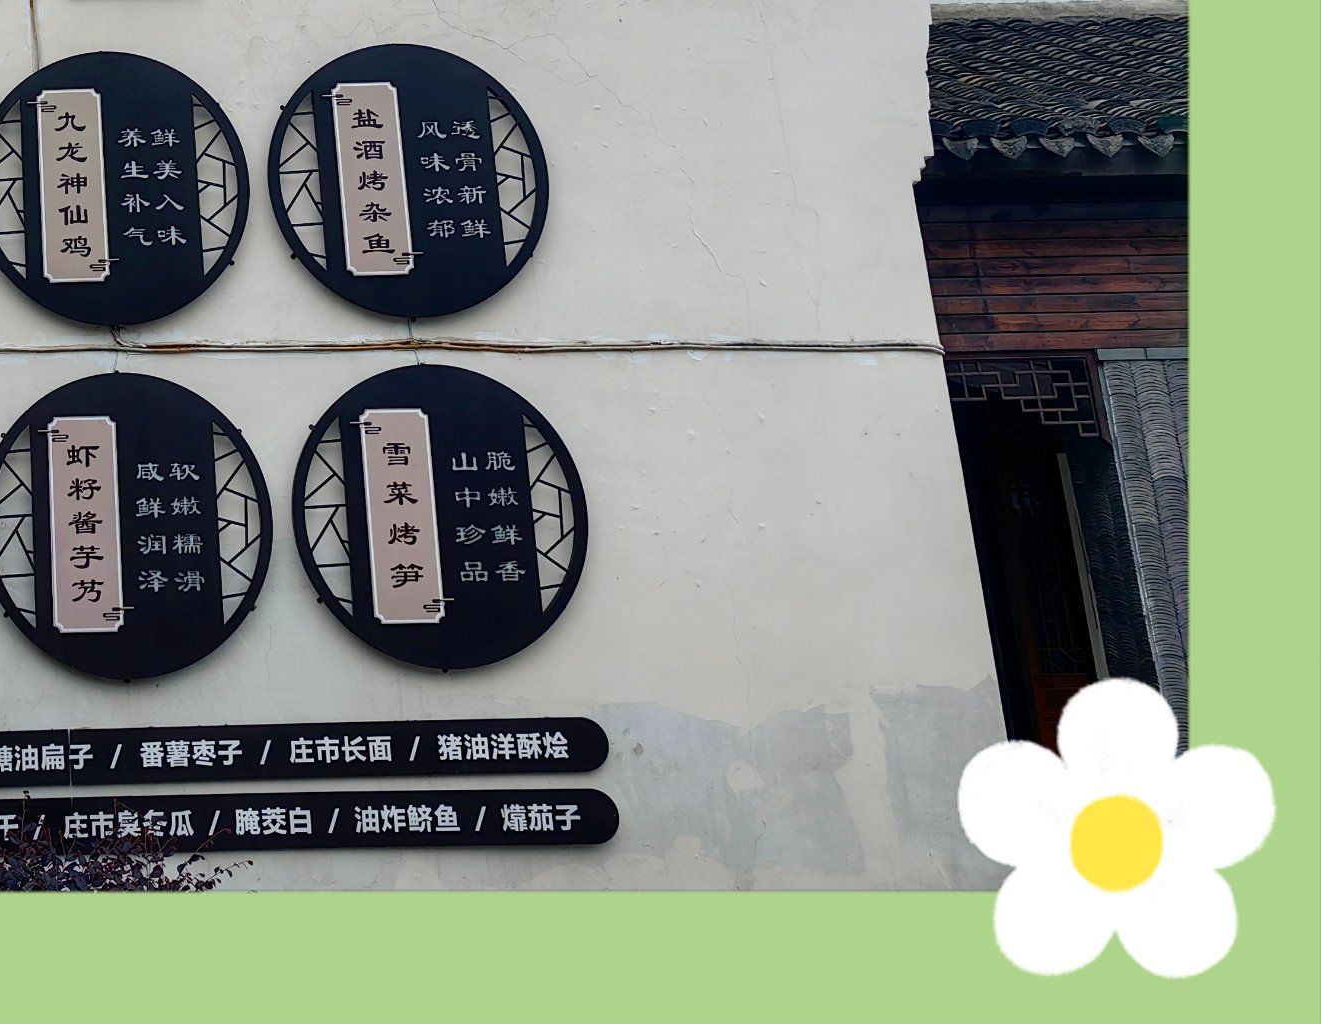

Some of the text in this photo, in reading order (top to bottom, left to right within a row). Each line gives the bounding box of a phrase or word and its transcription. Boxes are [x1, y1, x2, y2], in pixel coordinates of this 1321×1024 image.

[55, 112, 92, 258] 九龙神仙鸡
[117, 127, 153, 247] 养生补气
[151, 128, 187, 246] 鲜美入味
[350, 108, 396, 254] 盐酒烤杂鱼
[417, 120, 456, 239] 风味浓郁
[451, 120, 492, 239] 透骨新鲜
[66, 444, 105, 603] 虾籽酱芋艿
[135, 462, 170, 593] 咸鲜润泽
[169, 462, 205, 593] 软嫩糯滑
[382, 442, 424, 589] 雪菜烤笋
[452, 451, 489, 582] 山中珍品
[484, 451, 526, 582] 脆嫩鲜香
[139, 739, 243, 768] 番薯枣子
[289, 735, 392, 764] 庄市长面
[436, 731, 570, 761] 猪油洋酥烩
[235, 806, 313, 836] 腌茭白
